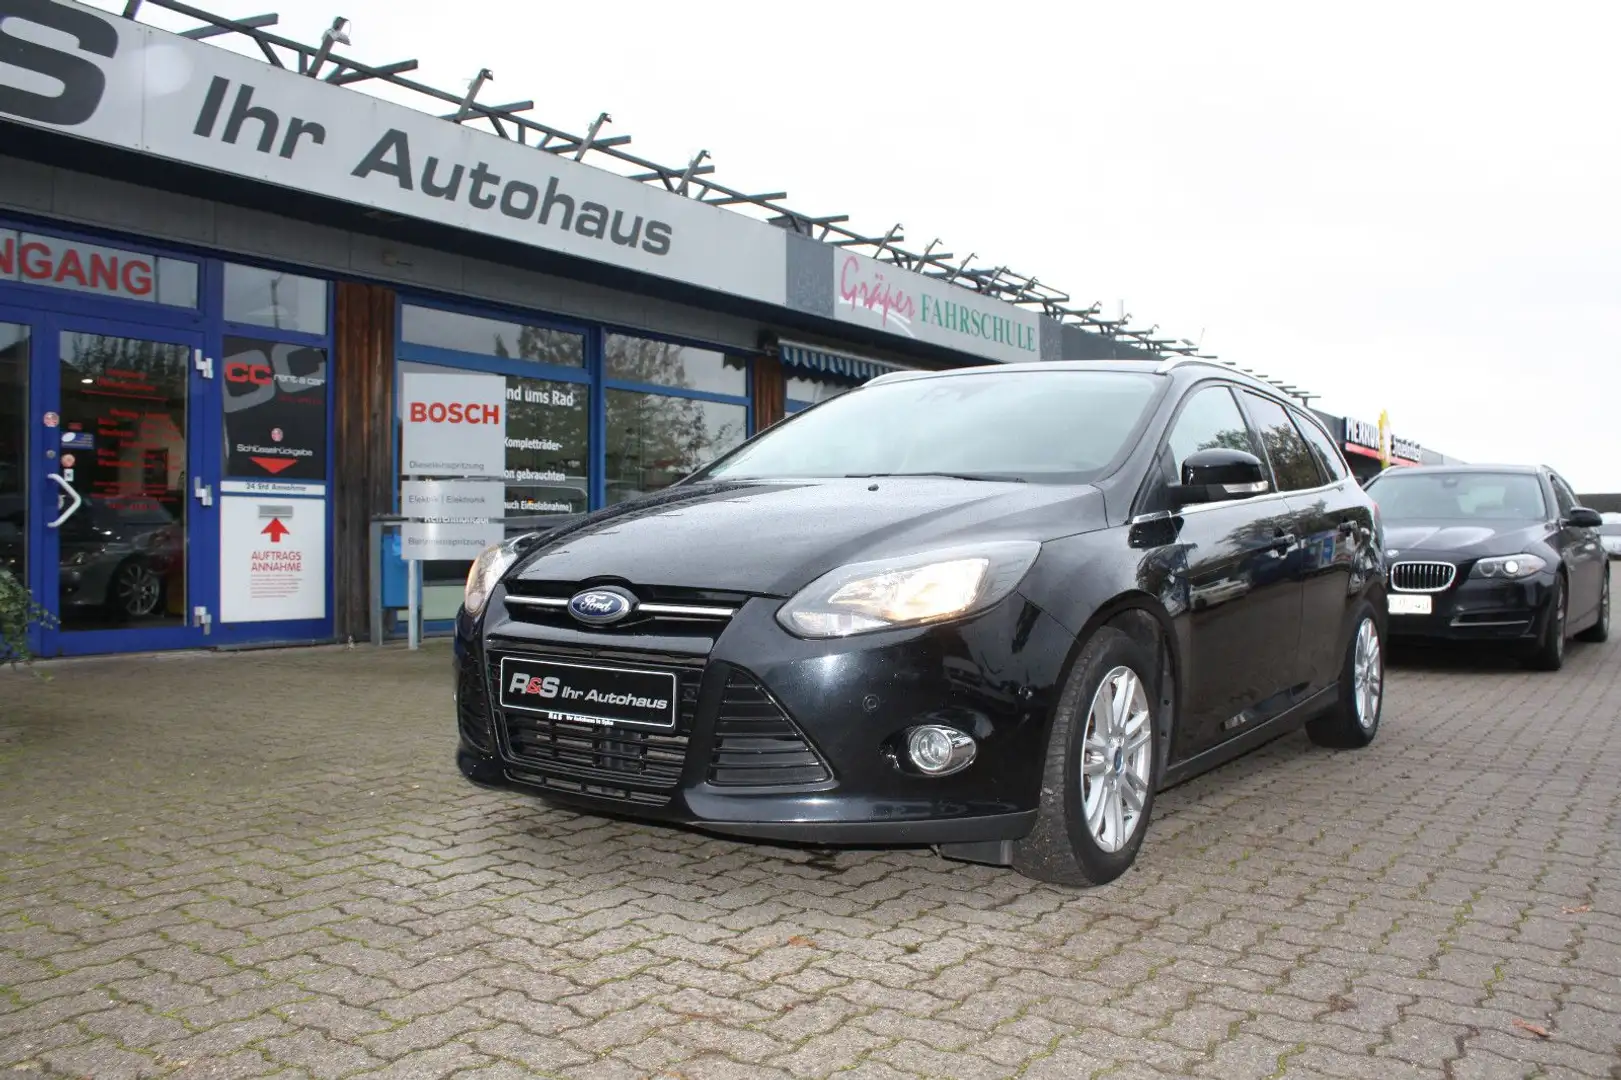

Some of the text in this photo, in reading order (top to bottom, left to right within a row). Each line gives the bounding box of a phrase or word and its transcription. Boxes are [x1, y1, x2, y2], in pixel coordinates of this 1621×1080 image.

[194, 76, 325, 160] Ihr
[351, 128, 672, 255] Autohaus
[840, 255, 1036, 352] Gräper FAHRSCHULE
[225, 362, 271, 385] CC
[506, 386, 574, 406] nd ums Rad
[410, 402, 499, 425] BOSCH
[503, 468, 565, 482] on gebrauchten
[251, 551, 302, 561] AUFTRAGS
[251, 562, 302, 572] ANNAHME
[580, 594, 614, 613] Ford
[509, 672, 668, 710] R&S Ihr Autohaus
